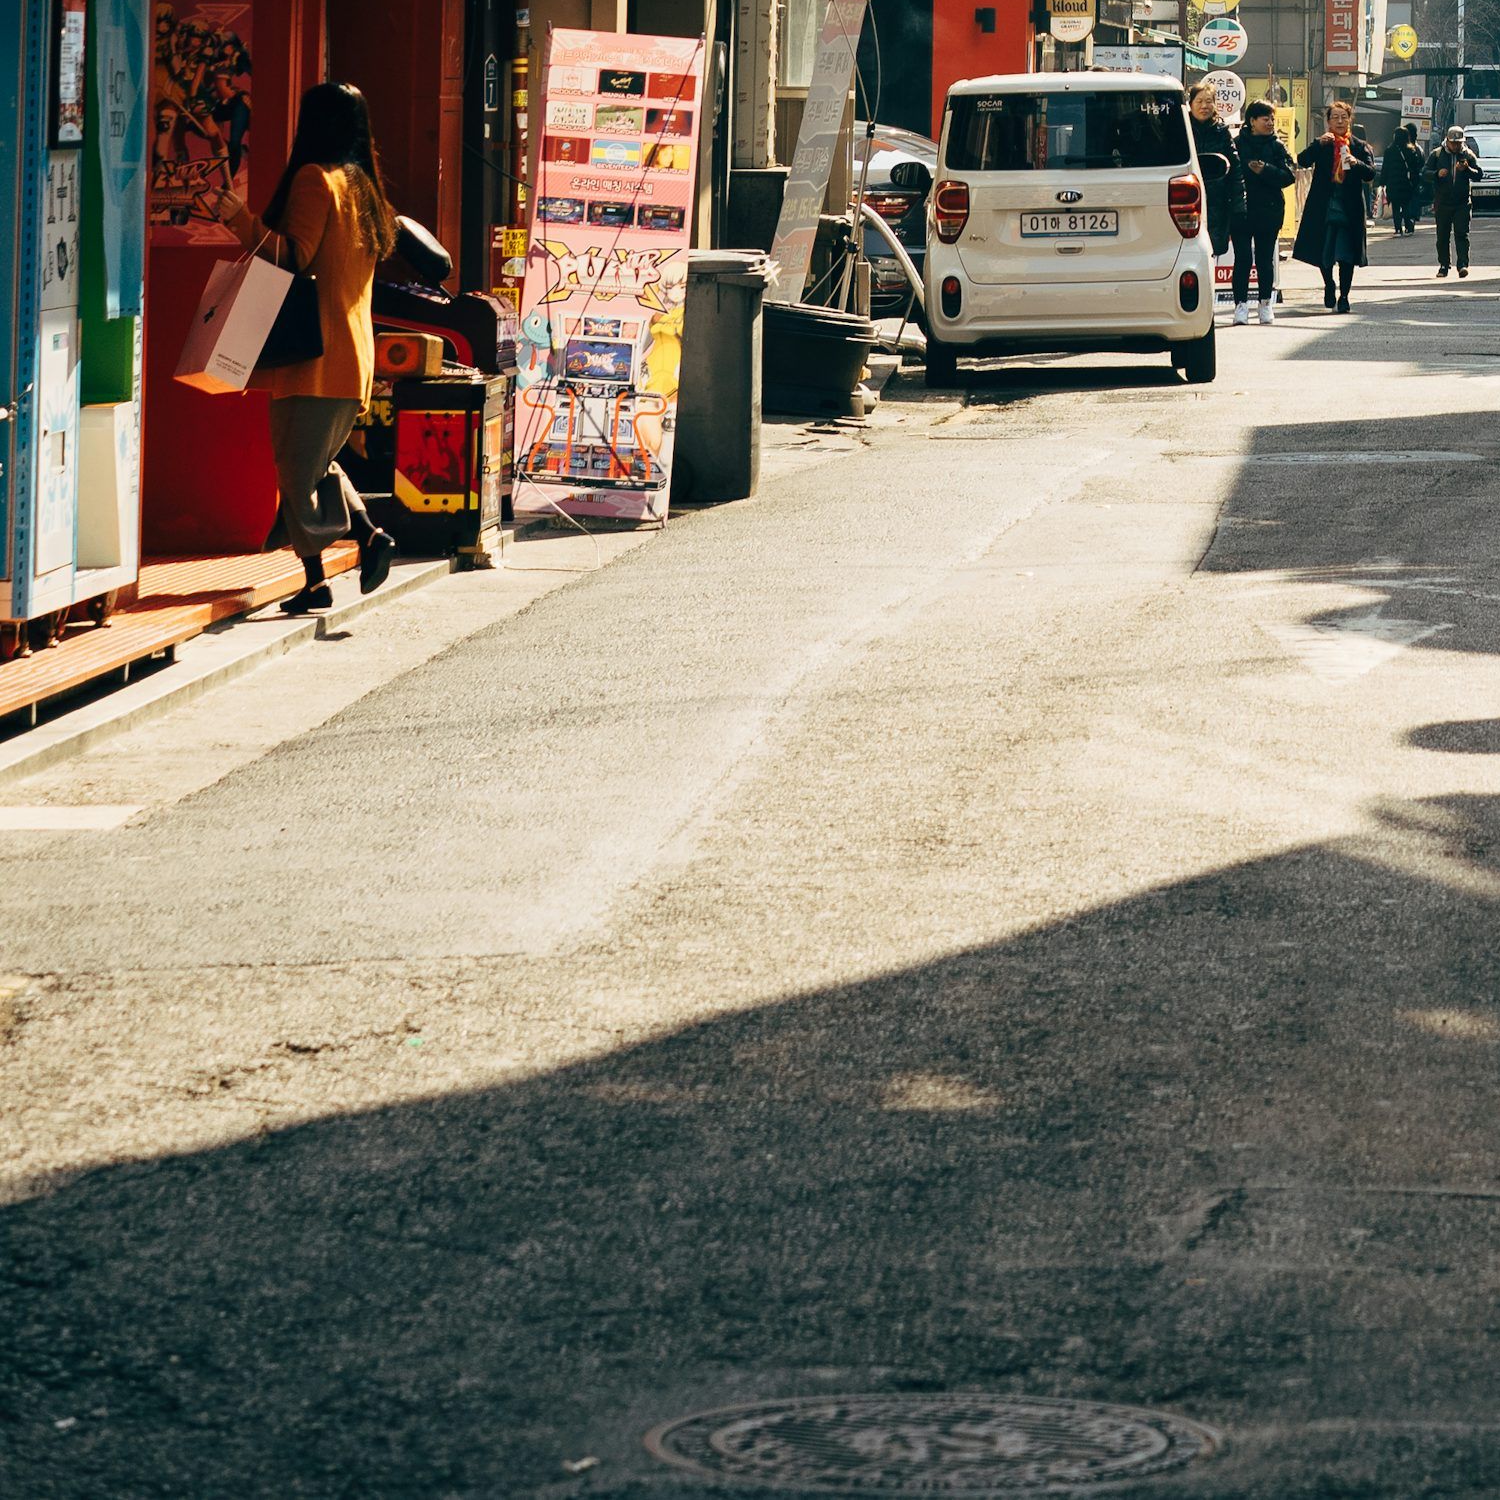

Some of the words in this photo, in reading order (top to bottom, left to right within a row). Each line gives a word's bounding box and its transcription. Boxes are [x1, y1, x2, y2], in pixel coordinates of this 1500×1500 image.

[1202, 35, 1241, 50] GS25
[977, 100, 1003, 108] SOCAR
[1140, 102, 1170, 115] 나눔카
[570, 175, 602, 191] 온라인
[602, 179, 622, 193] 매칭
[624, 182, 654, 196] 시스템
[1058, 191, 1080, 202] KIA
[1068, 213, 1110, 230] 8126
